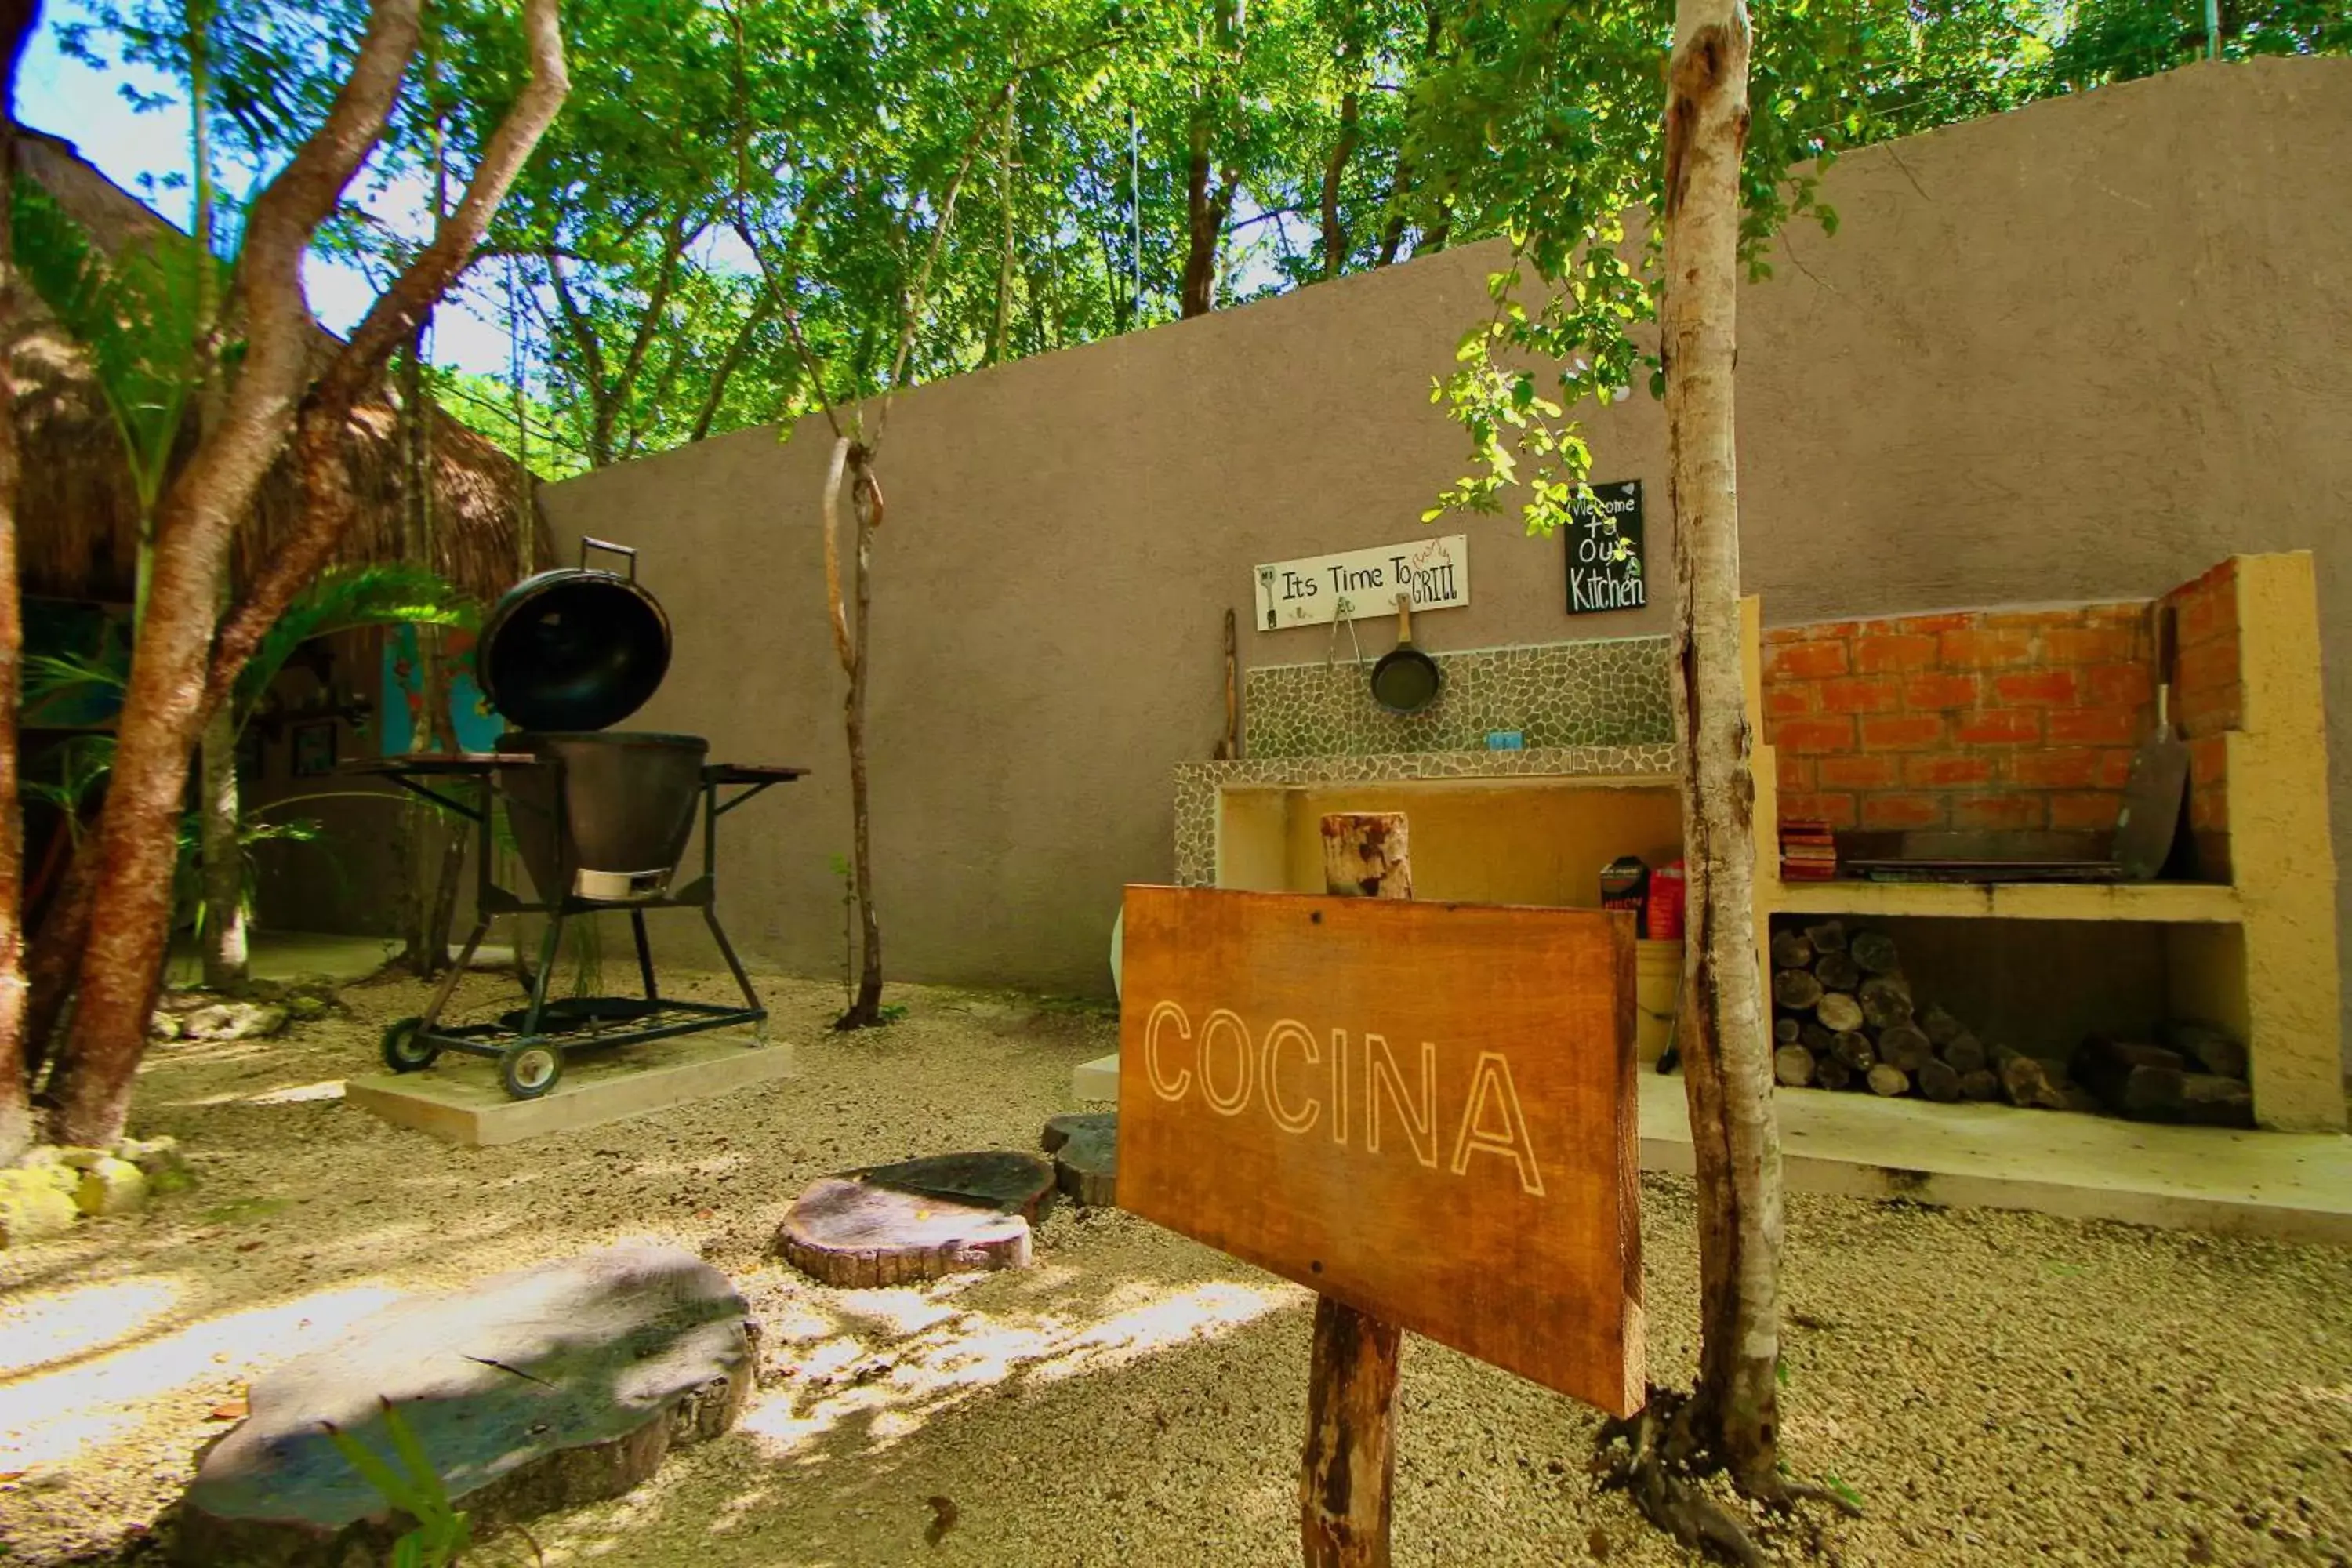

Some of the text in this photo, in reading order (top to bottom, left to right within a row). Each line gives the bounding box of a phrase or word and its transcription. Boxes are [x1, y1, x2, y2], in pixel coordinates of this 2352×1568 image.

[1579, 539, 1621, 562] Ou
[1281, 556, 1457, 604] Its Time To GRILL
[1570, 568, 1646, 611] Kitchen
[1145, 1000, 1545, 1196] COCINA
